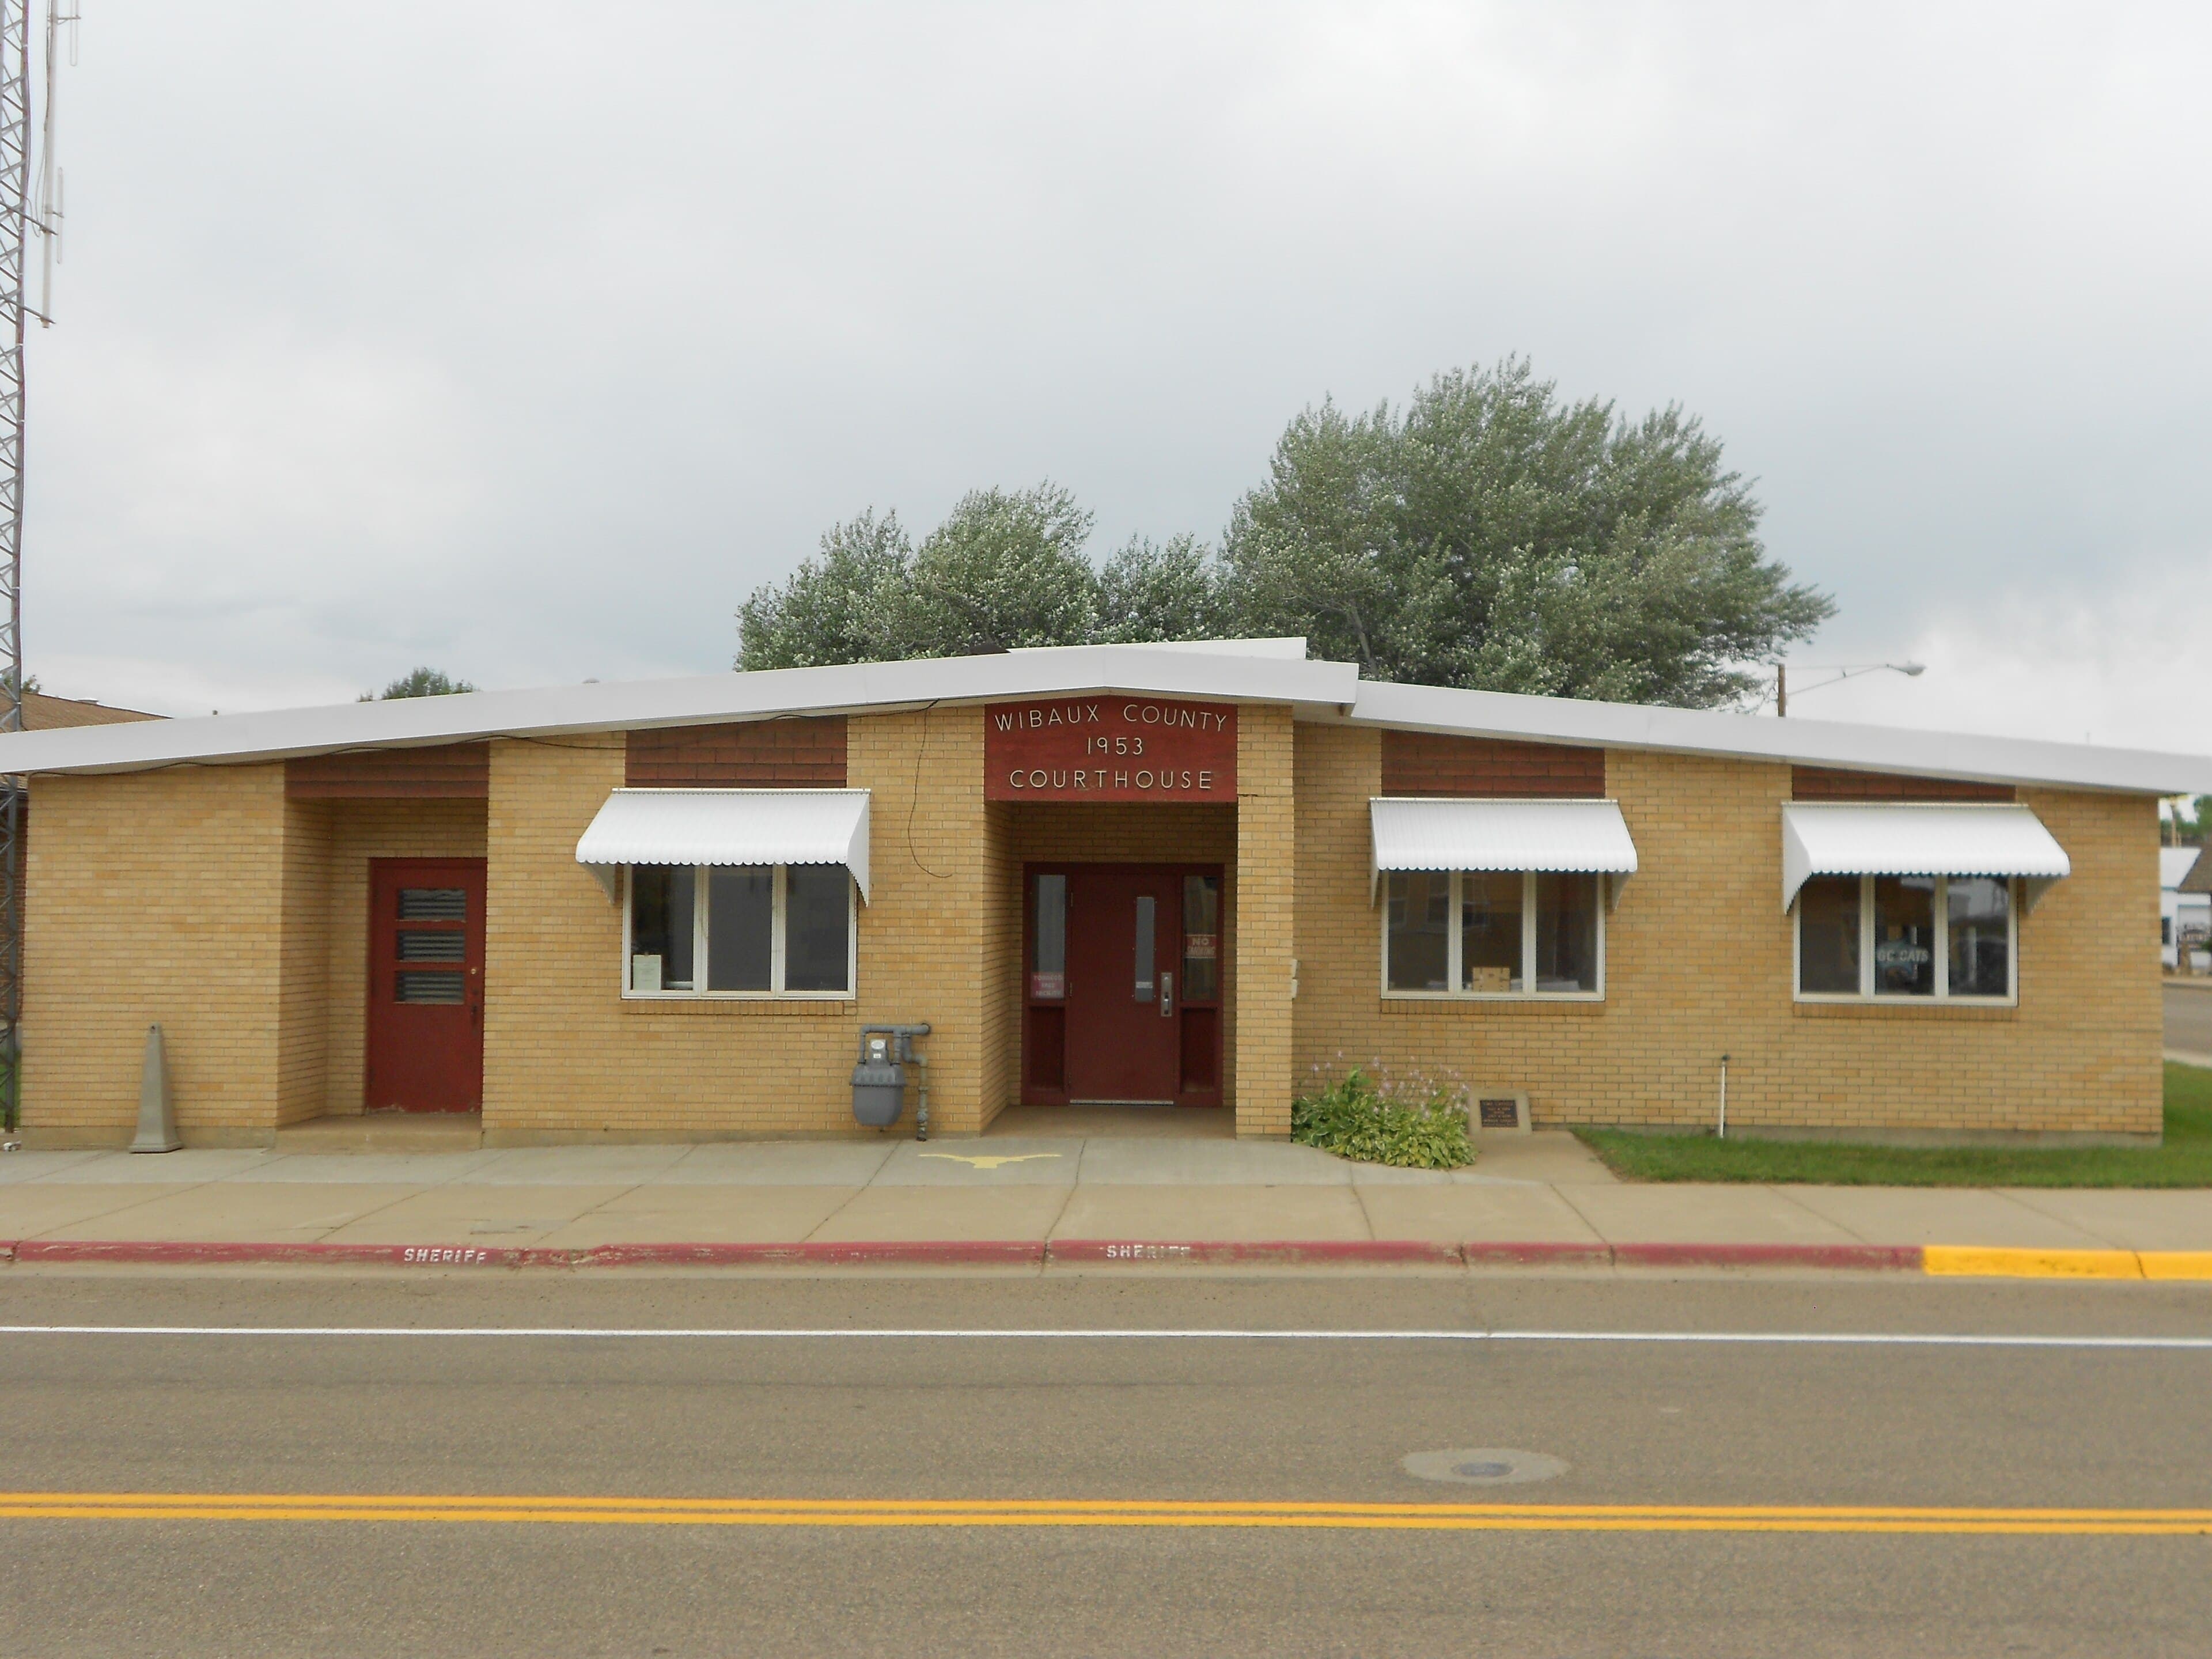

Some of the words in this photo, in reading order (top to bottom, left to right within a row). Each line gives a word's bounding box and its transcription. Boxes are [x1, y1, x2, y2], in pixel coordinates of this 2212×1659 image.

[995, 704, 1099, 731] WIBAUX
[1123, 704, 1228, 732] COUNTY
[1087, 737, 1143, 755] 1953
[1010, 770, 1211, 789] COURTHOUSE
[1192, 937, 1209, 945] NO
[404, 1248, 486, 1264] SHERIFF
